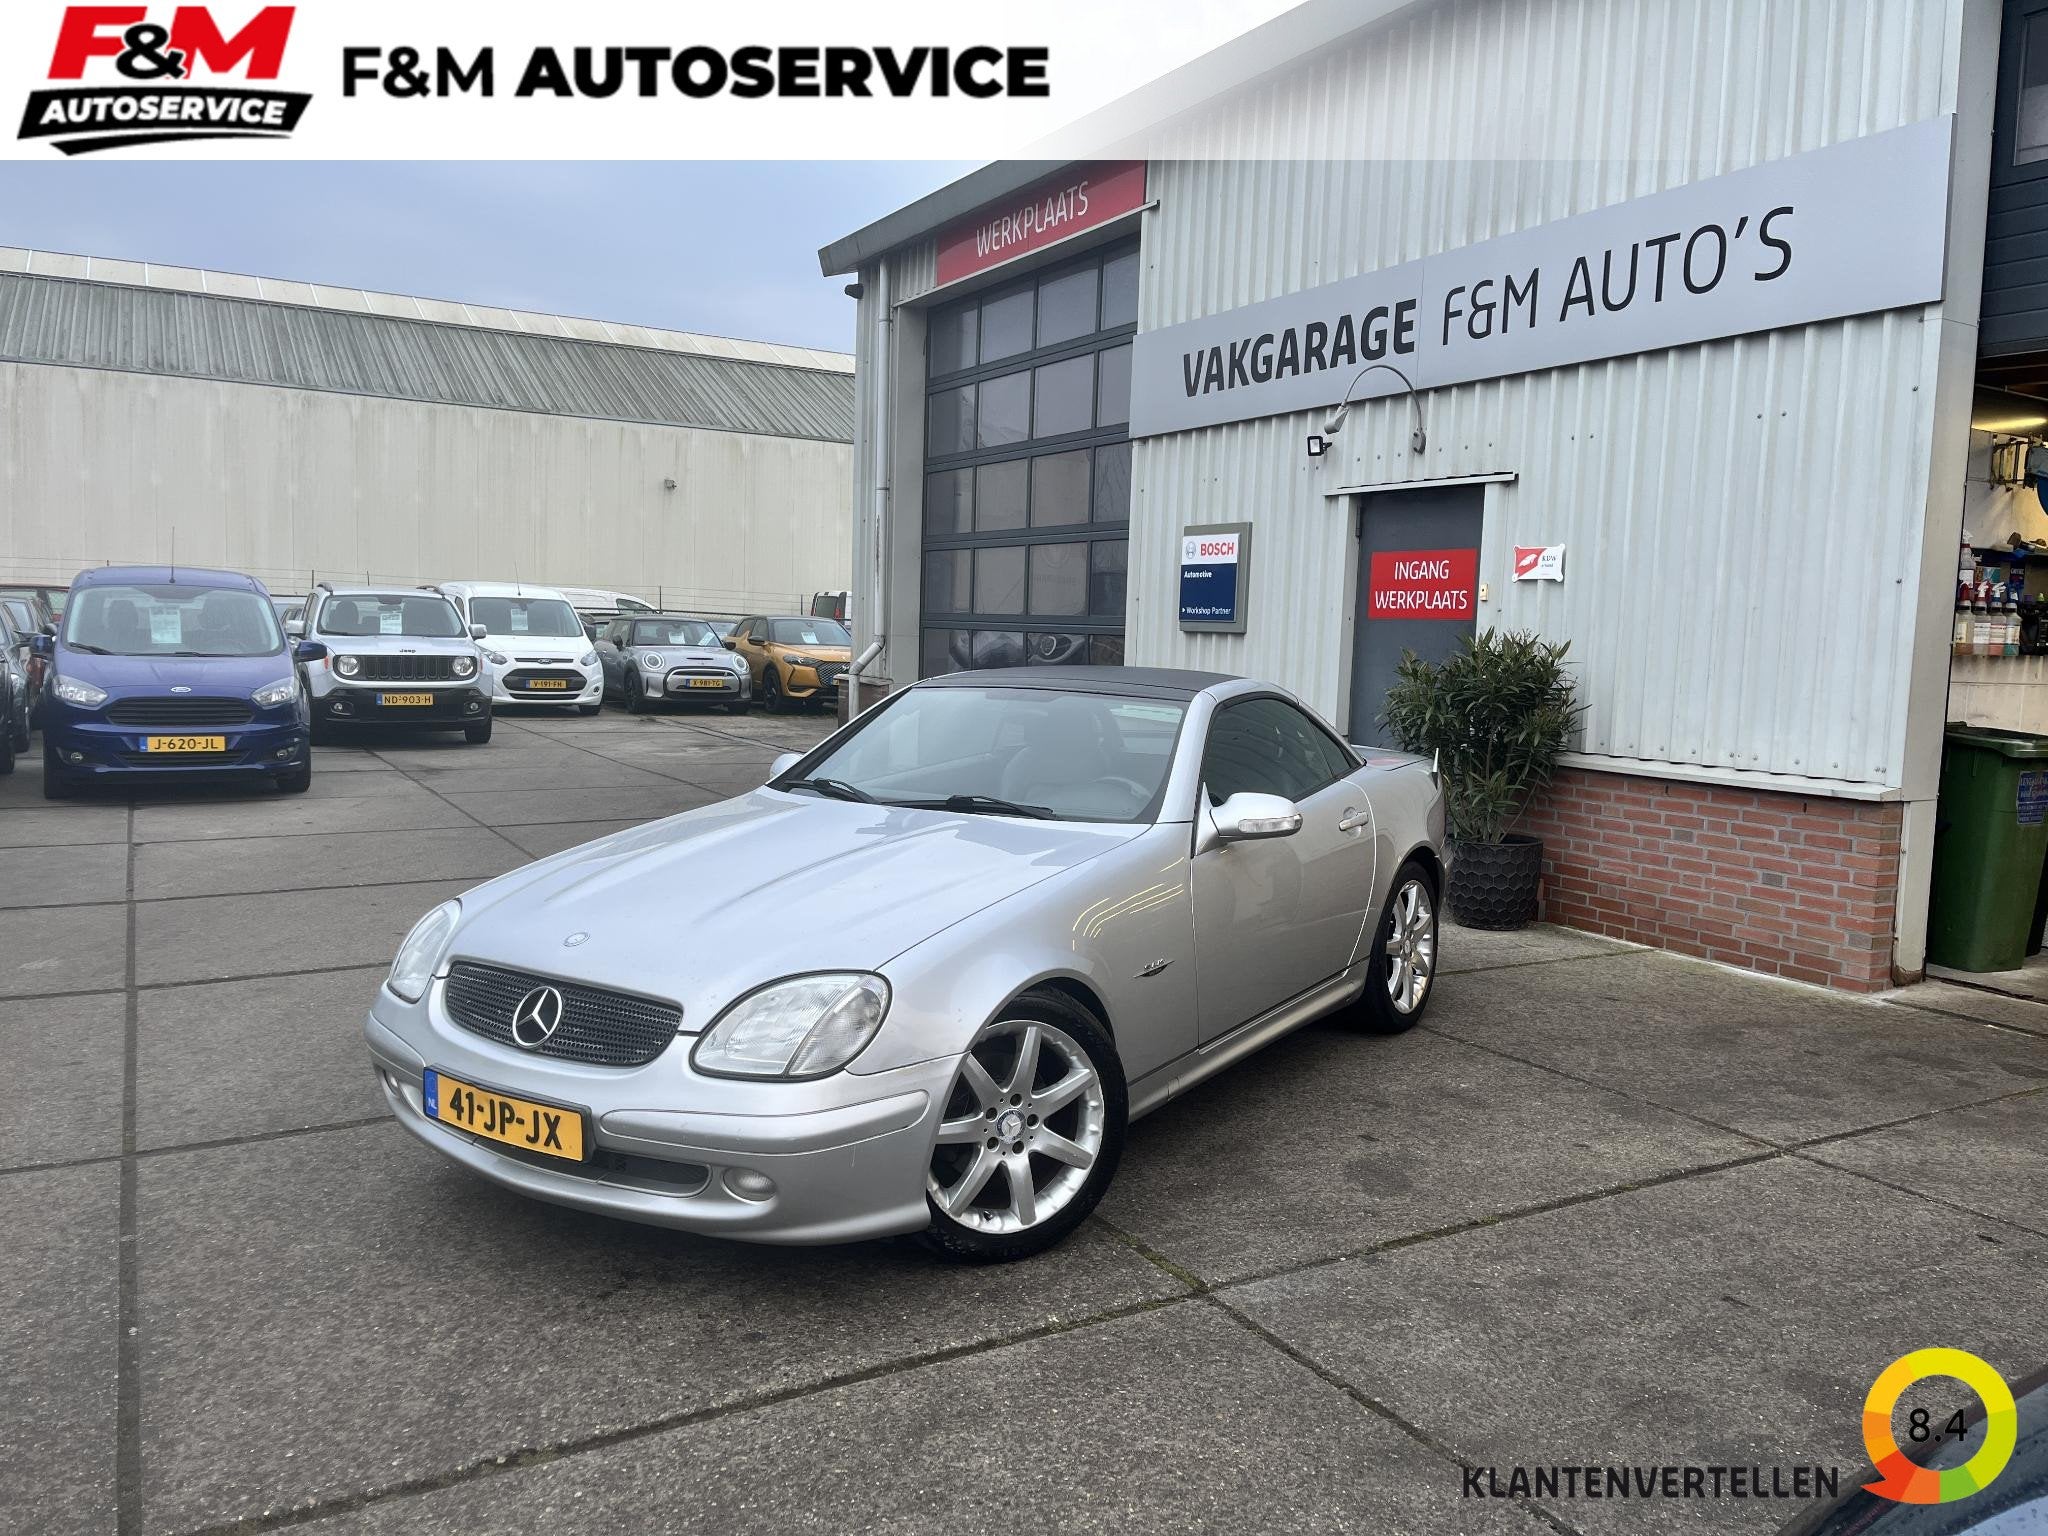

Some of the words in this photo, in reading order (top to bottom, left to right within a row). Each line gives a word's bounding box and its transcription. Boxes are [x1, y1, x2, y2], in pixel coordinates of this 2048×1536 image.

[976, 181, 1089, 257] WERKPLAATS
[1183, 298, 1417, 397] VAKGARAGE
[1442, 267, 1541, 345] F&M
[1560, 206, 1794, 322] AUTO'S
[1200, 542, 1235, 556] BOSCH
[1183, 570, 1213, 578] Automotive
[1394, 560, 1450, 580] INGANG
[1375, 590, 1468, 610] WERKPLAATS
[1186, 606, 1211, 615] Workshop
[1211, 606, 1232, 615] Partner
[384, 695, 431, 704] ND-903-H
[154, 738, 219, 750] J-620-JL
[449, 1087, 562, 1150] 41-JP-JX
